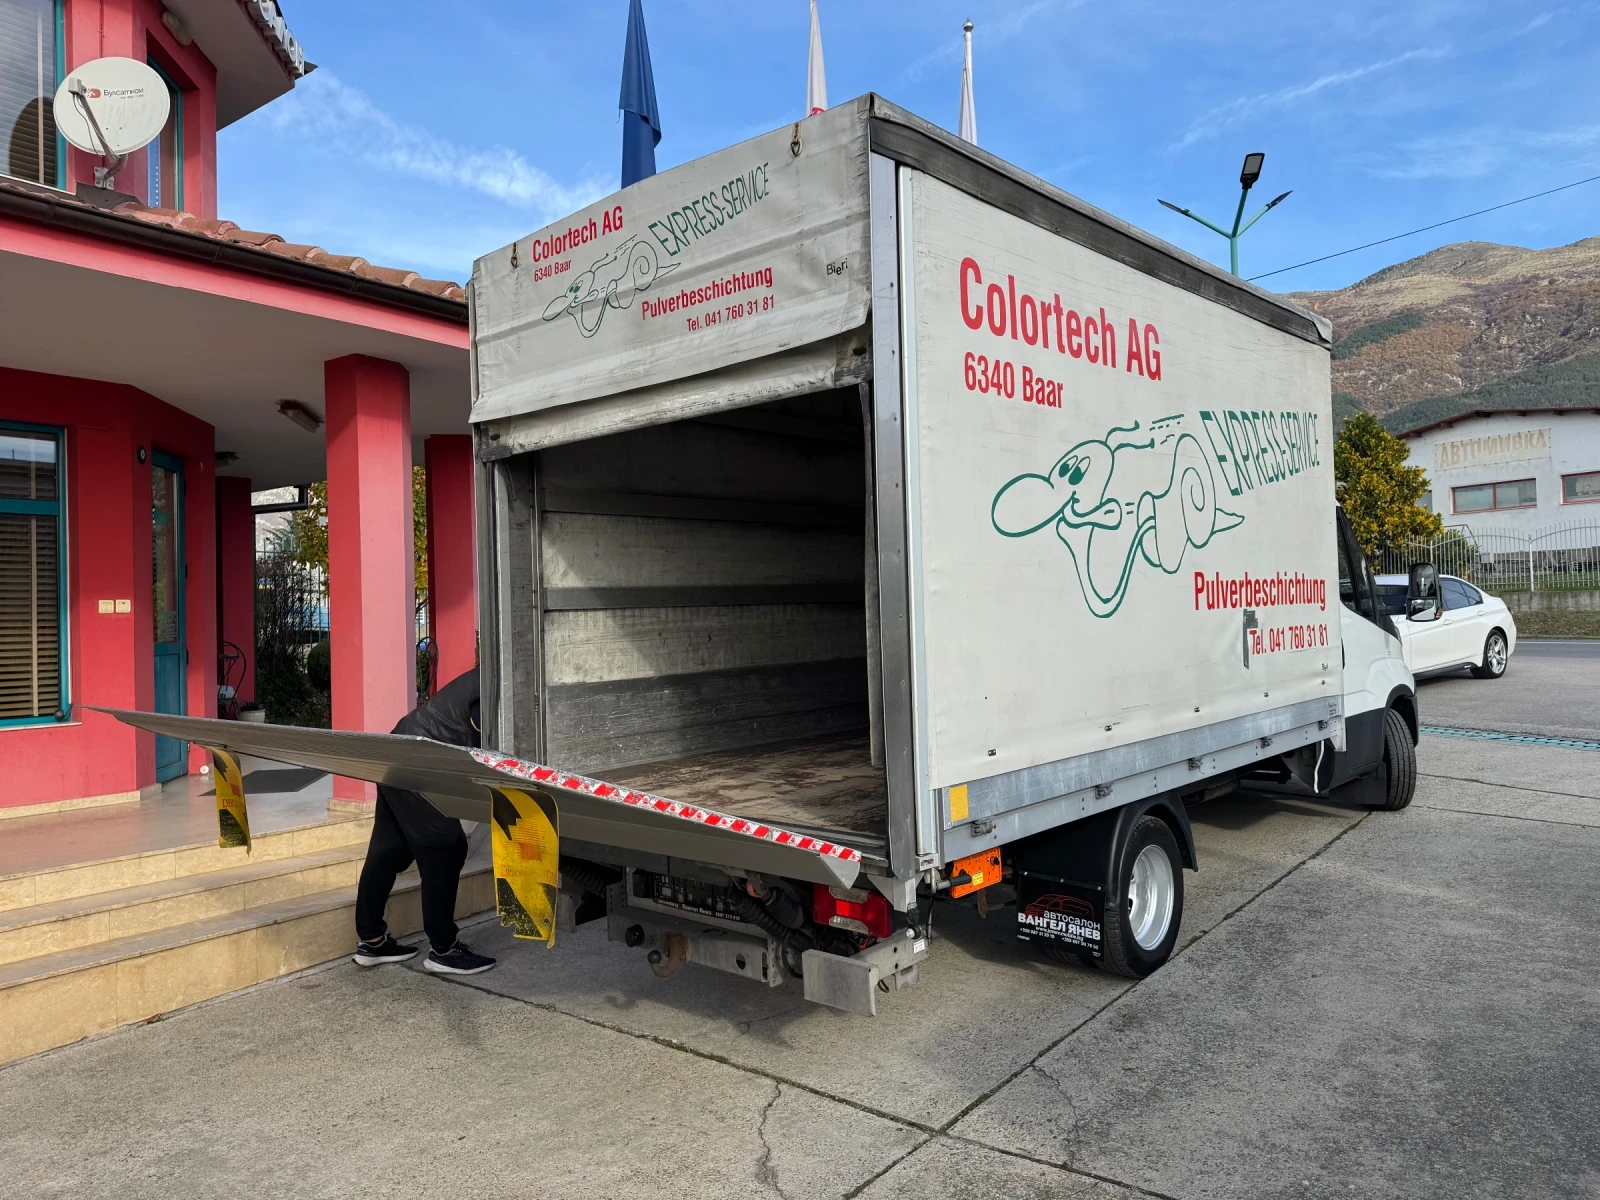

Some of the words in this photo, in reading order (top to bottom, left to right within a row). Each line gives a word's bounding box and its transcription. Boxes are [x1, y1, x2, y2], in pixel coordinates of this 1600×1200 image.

[648, 162, 770, 257] EXPRESS-SERVICE
[532, 218, 598, 263] Colortech
[601, 205, 624, 236] AG
[534, 264, 553, 282] 6340
[554, 258, 572, 275] Baar
[826, 257, 849, 277] Bieri
[641, 266, 773, 320] Pulverbeschichtung
[686, 317, 702, 333] Tel.
[704, 312, 721, 329] 041
[724, 307, 744, 324] 760
[746, 302, 759, 318] 31
[762, 296, 775, 312] 81
[959, 256, 1117, 369] Colortech
[1126, 317, 1162, 381] AG
[963, 351, 1016, 400] 6340
[1022, 365, 1064, 409] Baar
[1199, 410, 1320, 496] EXPRESS-SERVICE
[1440, 430, 1547, 469] АВТОМИВКА
[1194, 571, 1326, 611] Pulverbeschichtung
[1249, 629, 1267, 655] Tel.
[1269, 626, 1287, 652] 041
[1288, 625, 1304, 650] 760
[1307, 625, 1317, 648] 31
[1319, 623, 1329, 647] 81
[1018, 912, 1066, 932] ВАНГЕЛ
[1068, 924, 1101, 941] ЯНЕВ
[1043, 910, 1101, 931] автосалон
